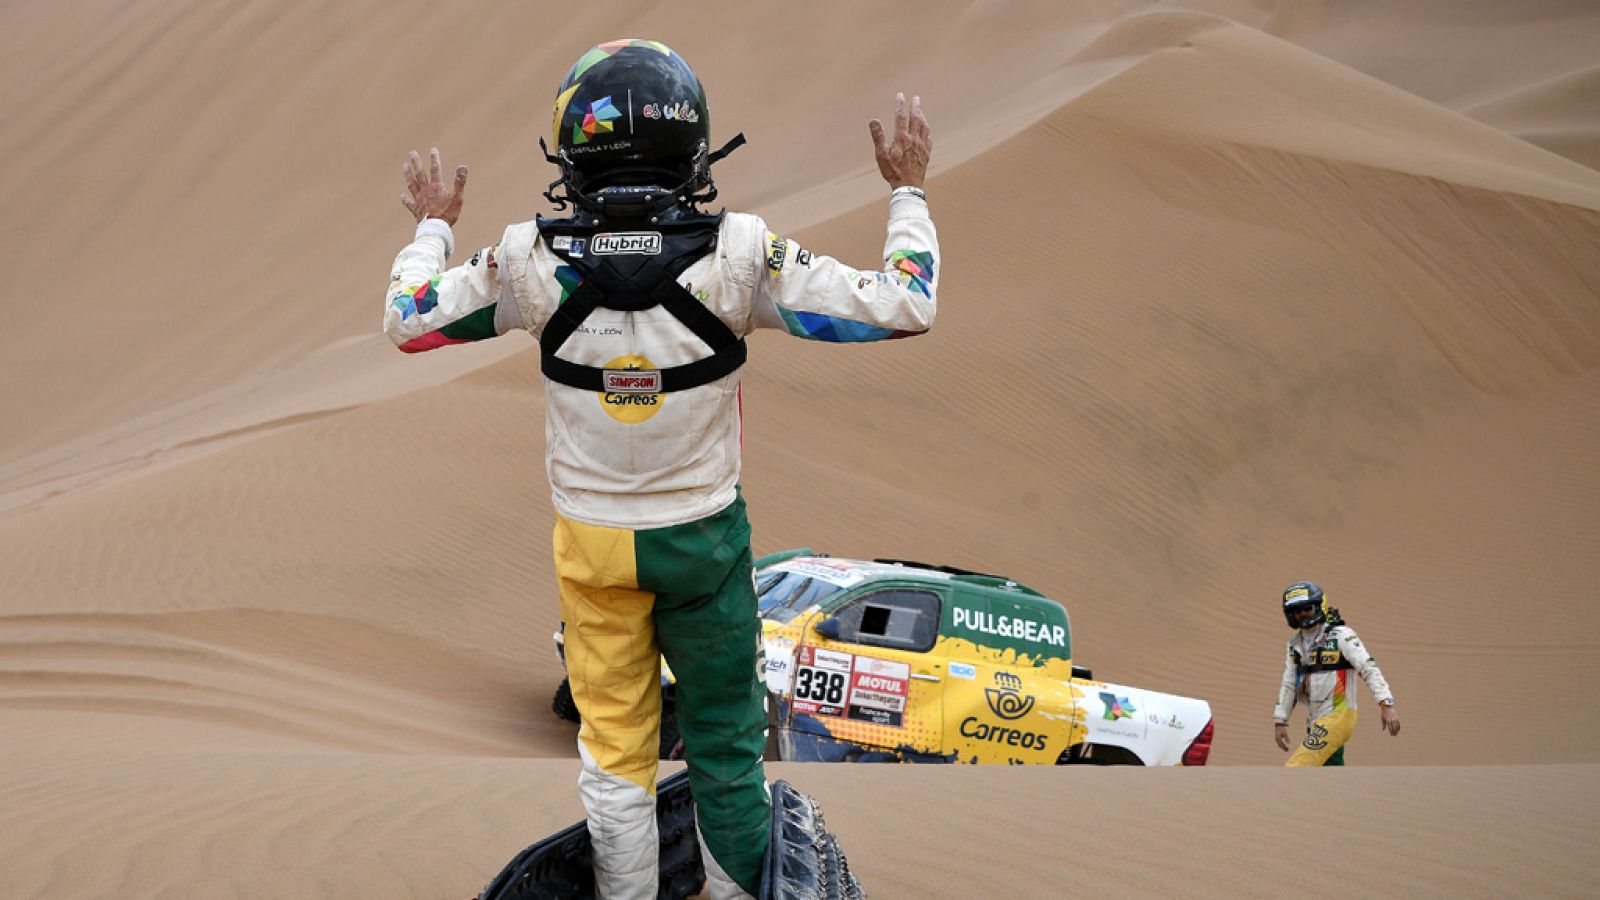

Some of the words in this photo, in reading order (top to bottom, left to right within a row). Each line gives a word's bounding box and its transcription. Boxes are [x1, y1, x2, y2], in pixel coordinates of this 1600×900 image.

[598, 236, 654, 252] Hybrid
[609, 376, 654, 389] SIMPSON
[605, 392, 658, 406] Correos
[953, 607, 1065, 647] PULL&BEAR
[796, 668, 845, 704] 338
[857, 674, 901, 693] MOTUL
[793, 702, 817, 712] MOTUL
[960, 716, 1048, 751] Correos
